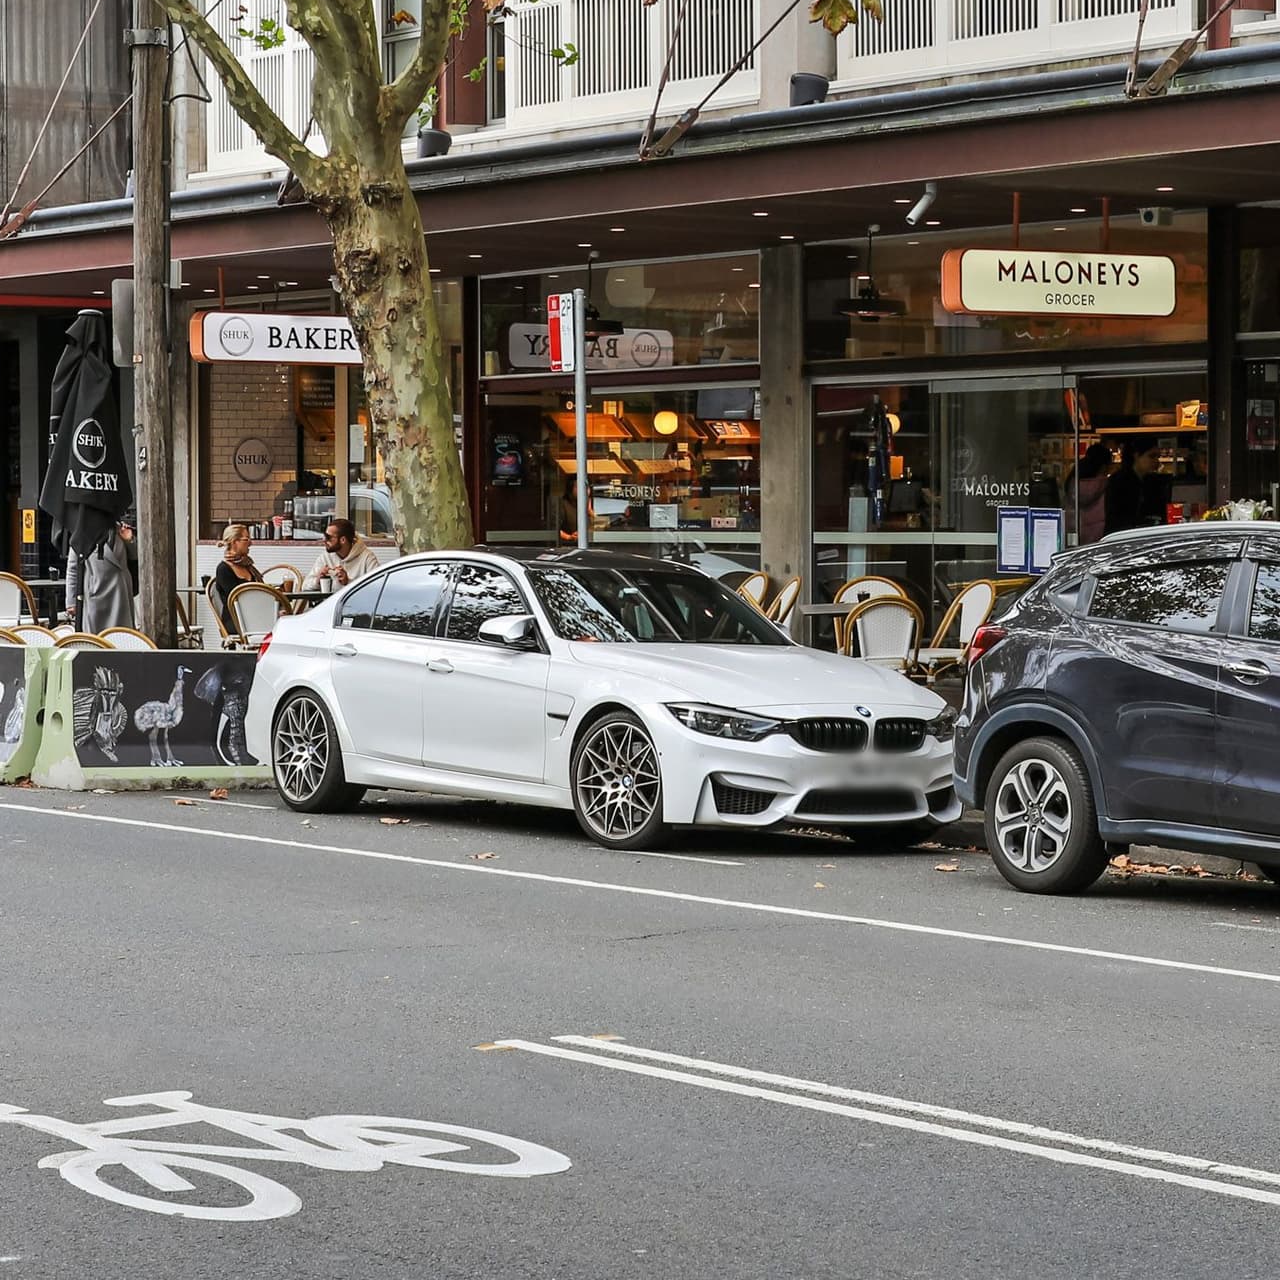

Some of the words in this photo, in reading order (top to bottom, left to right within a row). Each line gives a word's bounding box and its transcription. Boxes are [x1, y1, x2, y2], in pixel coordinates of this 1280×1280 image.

[998, 258, 1140, 287] MALONEYS
[1045, 293, 1096, 306] GROCER
[223, 330, 250, 340] SHUK
[267, 326, 357, 351] BAKER
[237, 455, 269, 465] SHUK
[65, 469, 119, 491] AKERY
[965, 483, 1031, 496] MALONEYS
